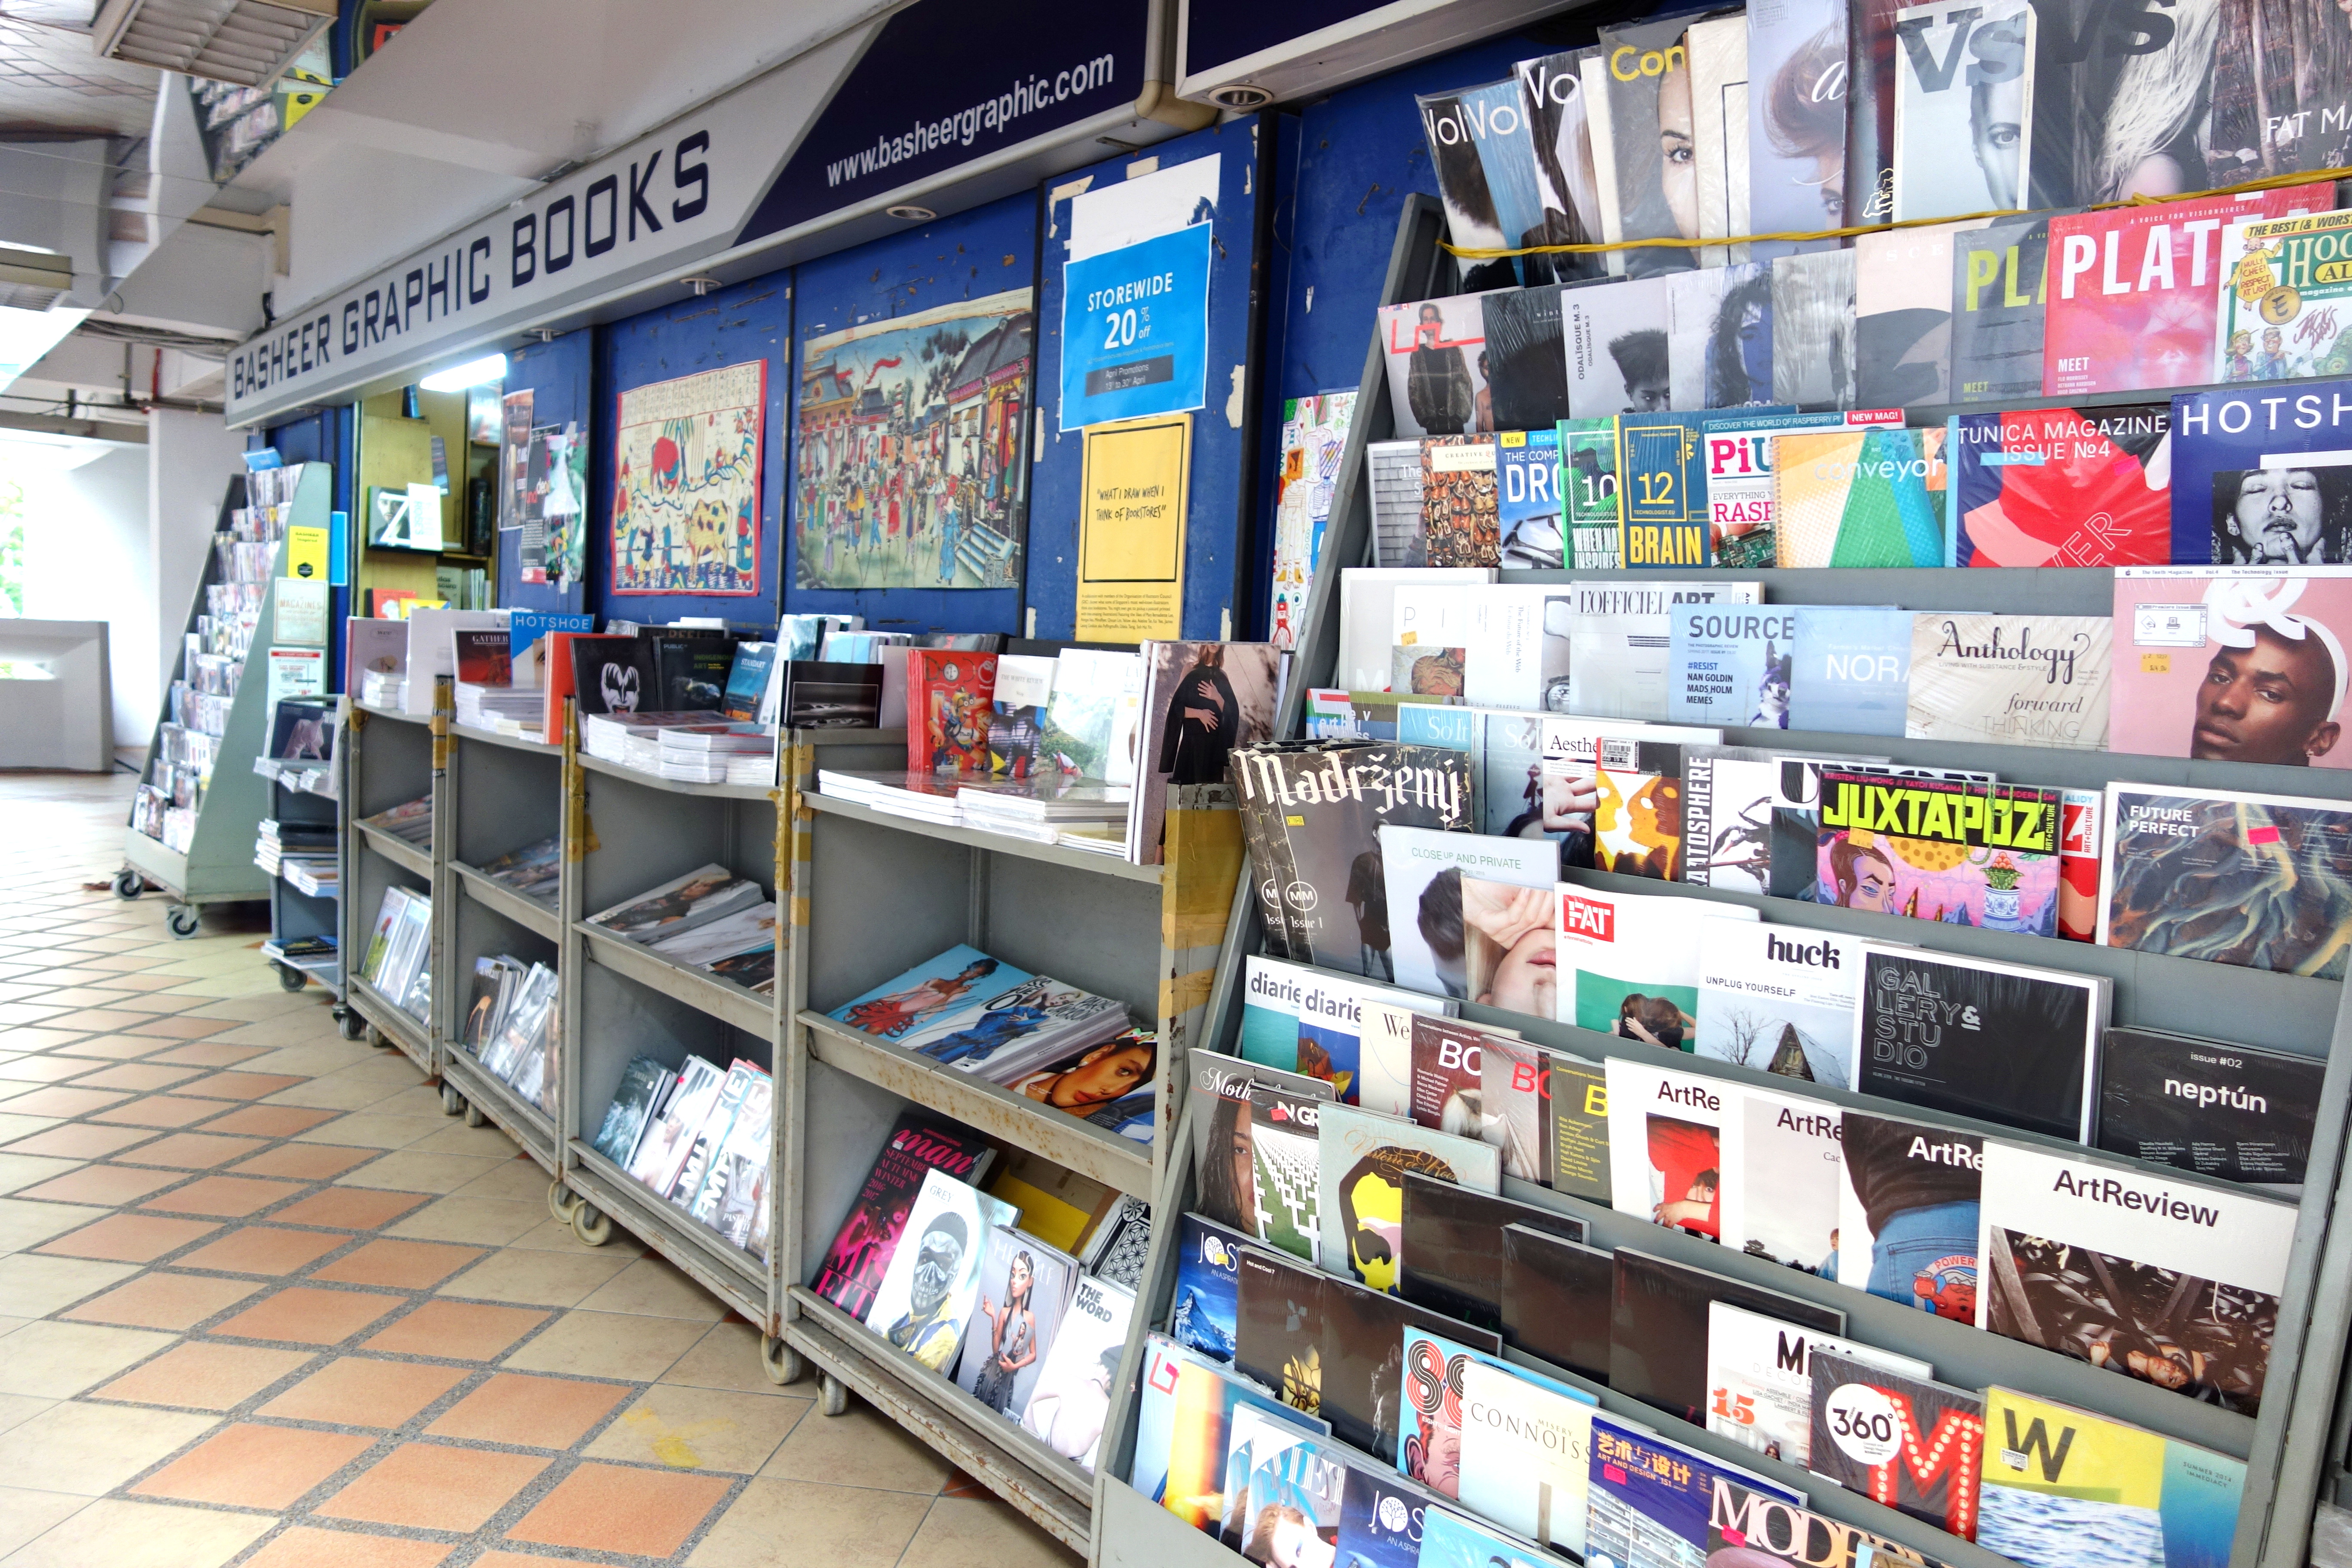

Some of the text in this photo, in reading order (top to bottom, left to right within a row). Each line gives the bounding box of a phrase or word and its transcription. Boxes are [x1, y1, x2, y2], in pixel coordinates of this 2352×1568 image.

[827, 53, 1114, 187] www.basheergraphic.com
[2266, 112, 2311, 144] FAT
[2188, 205, 2246, 218] VISIONAIRES
[2248, 221, 2295, 237] THE BEST
[234, 129, 710, 400] BASHEER GRAPHIC BOOKS
[2243, 258, 2263, 268] HULLY
[1087, 272, 1173, 312] STOREWIDE
[2240, 275, 2271, 289] RESPECT
[2243, 283, 2271, 297] AT LAST!
[2300, 286, 2344, 296] magazine
[1139, 325, 1152, 339] off
[2058, 357, 2090, 372] MEET
[1963, 382, 1988, 394] MEET
[1709, 421, 1741, 430] DISCOVER
[1756, 420, 1782, 428] WORLD
[1793, 416, 1832, 425] RASPBERRY
[1852, 411, 1899, 422] NEW MAG!
[1958, 414, 2167, 445] TUNICA MAGAZINE
[1506, 452, 1525, 462] THE
[2003, 442, 2065, 462] ISSUE
[1815, 456, 1944, 482] conveyor
[1124, 485, 1159, 499] DRAW WHEN
[1638, 472, 1675, 504] 12
[1713, 492, 1766, 500] EVERYTHING
[1096, 507, 1124, 521] THINK OF
[1573, 528, 1602, 552] WHEN
[1629, 526, 1702, 565] BRAIN
[515, 615, 589, 630] HOTSHOE
[1689, 616, 1795, 640] SOURCE
[472, 634, 508, 644] GATHER
[741, 657, 766, 669] STANDART
[1937, 620, 2091, 685] Anthology
[1687, 662, 1718, 671] #RESIST
[1011, 674, 1025, 683] WHITE
[1026, 676, 1044, 684] REVIEW
[1687, 673, 1733, 683] NAN GOLDIN
[1687, 684, 1733, 694] MADS HOLM
[1686, 695, 1713, 705] MEMES
[2003, 692, 2084, 715] forward
[1427, 715, 1452, 740] So
[1981, 715, 2080, 739] THINKING
[1824, 772, 1963, 792] KRISTEN LIU-WONG YAYOI KUSAMA
[1823, 783, 2047, 850] JUXTAPOZ
[2130, 805, 2192, 822] FUTURE
[2045, 803, 2055, 851] ART+CULTURE
[2083, 805, 2093, 853] ART+CULTURE
[2129, 821, 2199, 838] PERFECT
[1412, 847, 1522, 870] CLOSE UP AND PRIVATE
[1290, 916, 1315, 929] Issue
[1568, 900, 1611, 935] FAT
[1767, 933, 1840, 970] huck
[1706, 976, 1796, 998] UNPLUG YOURSELF
[1879, 966, 1941, 999] GAL
[1876, 989, 1960, 1026] LERY
[1382, 1012, 1409, 1040] We
[1874, 1014, 1941, 1047] STU
[1873, 1037, 1928, 1070] DIO
[2190, 1052, 2242, 1069] issue #02
[2164, 1078, 2266, 1113] neptún
[891, 1129, 974, 1174] man
[874, 1167, 906, 1189] WINTER
[930, 1185, 954, 1203] GREY
[2053, 1170, 2219, 1228] ArtReview
[993, 1238, 1054, 1286] HERSELF
[1262, 1265, 1272, 1273] Cool
[1935, 1255, 1975, 1270] POWER
[1079, 1283, 1103, 1305] THE
[1075, 1294, 1112, 1323] WORD
[1767, 1388, 1792, 1400] ASSEMBLE
[1537, 1418, 1573, 1437] MISERY
[2003, 1407, 2076, 1484] W
[1597, 1431, 1691, 1485] 艺术与设计
[1597, 1453, 1672, 1487] ART AND DESIGN 151
[2183, 1461, 2233, 1483] SUMMER 2014
[2187, 1470, 2228, 1489] IMMEDIACY
[1387, 1535, 1398, 1545] AN
